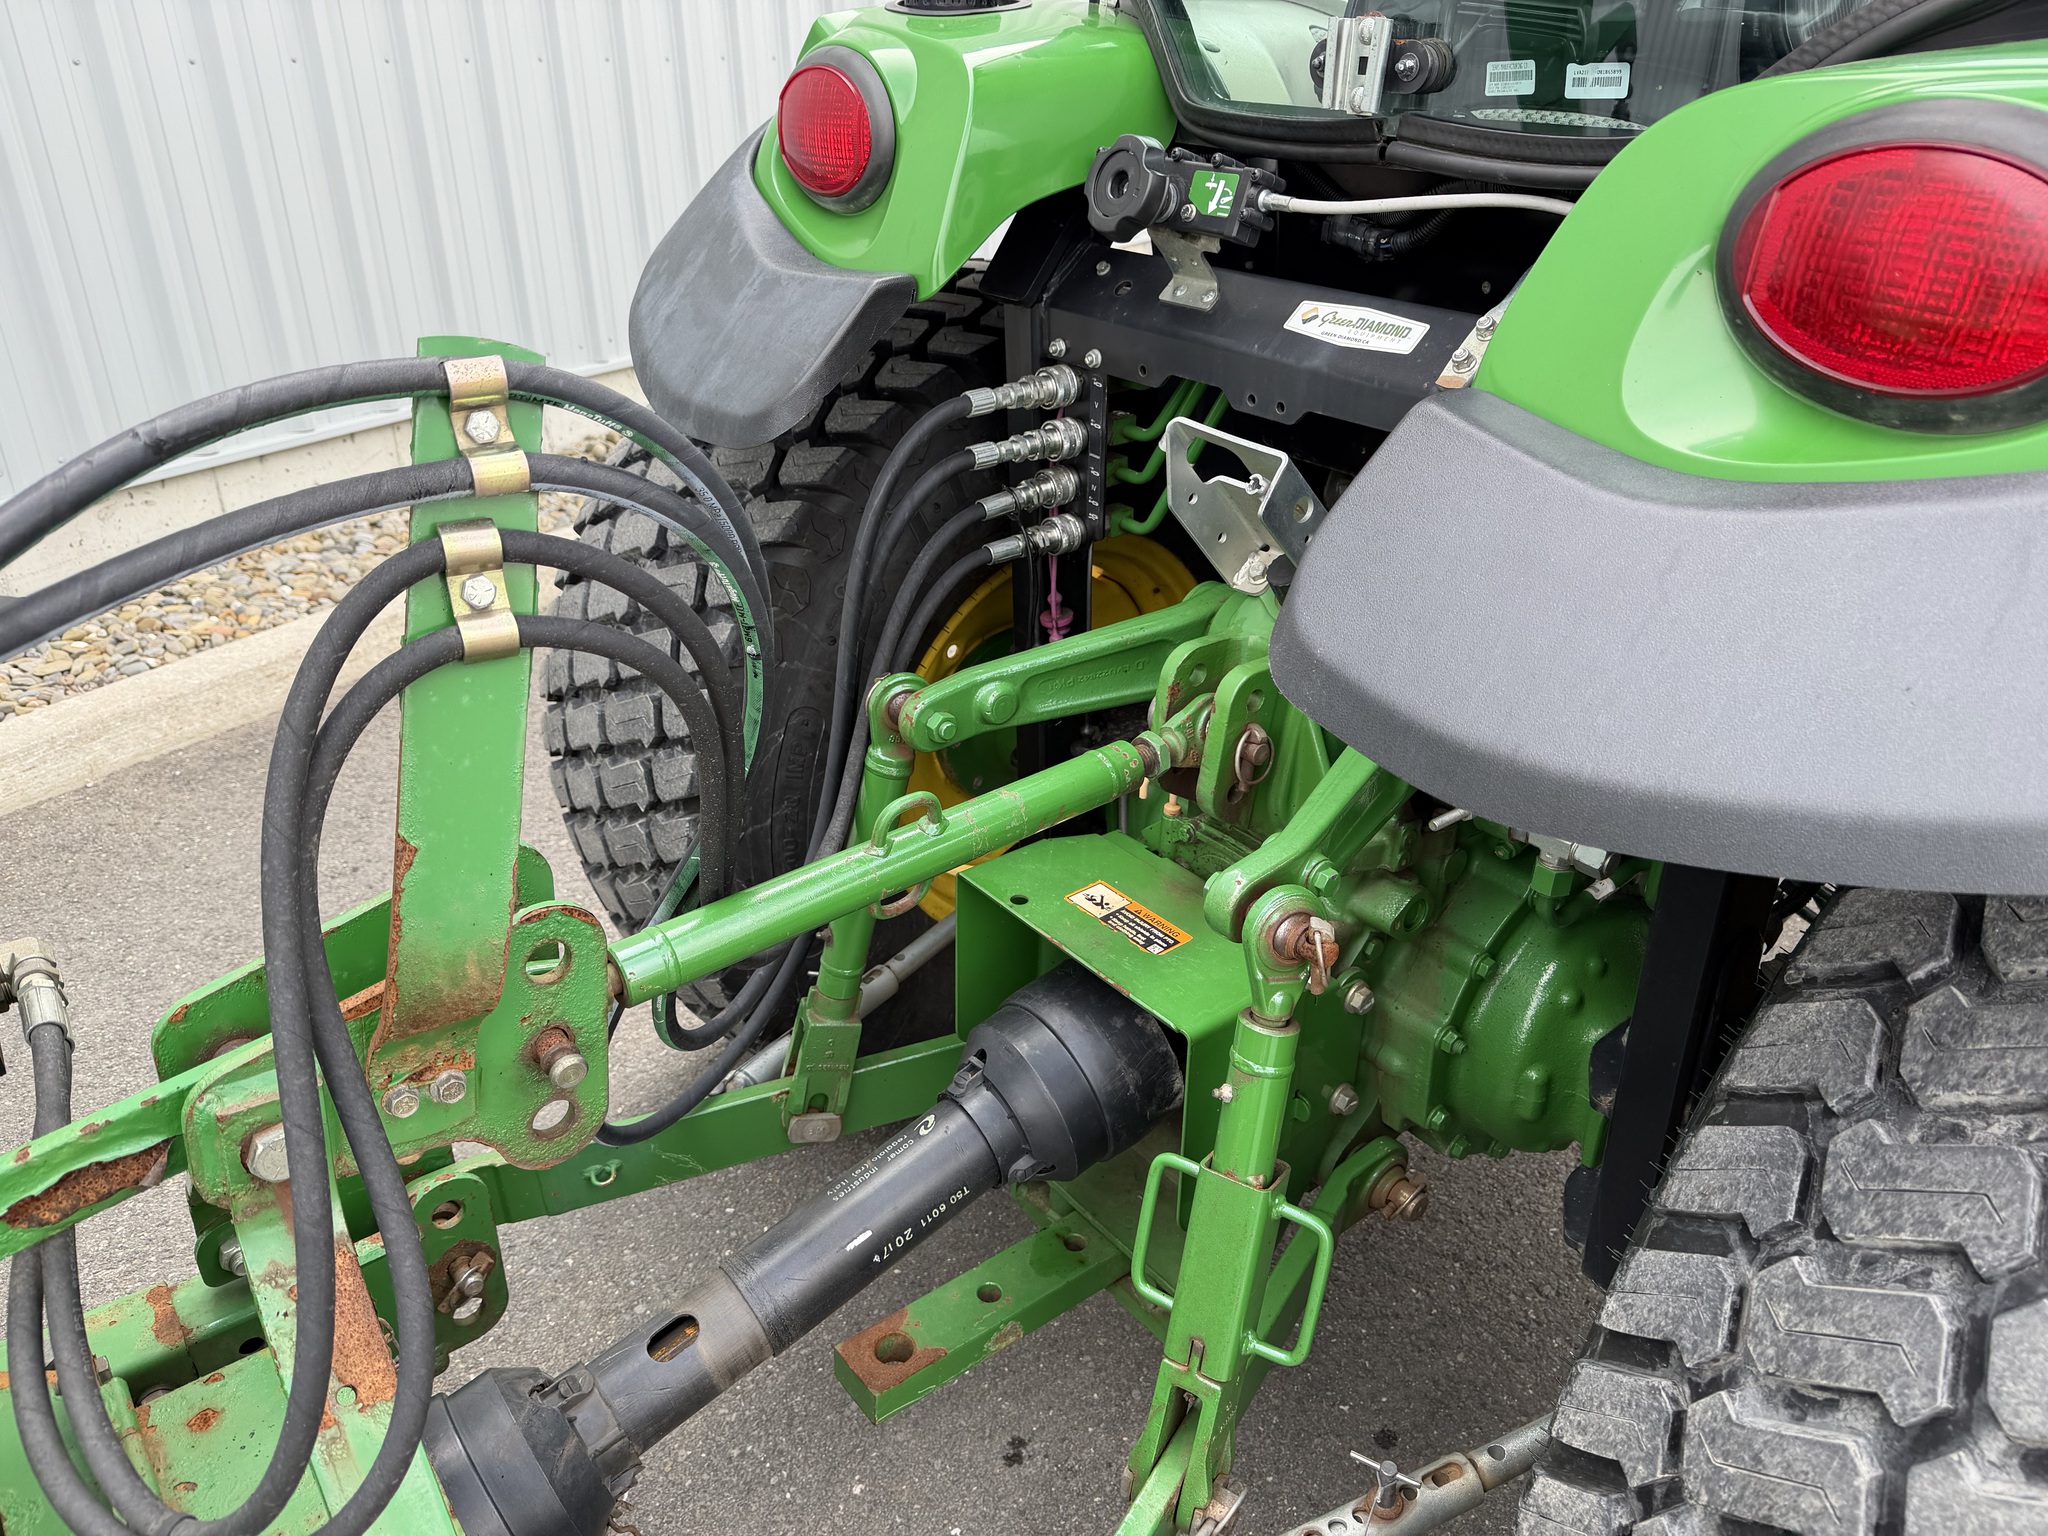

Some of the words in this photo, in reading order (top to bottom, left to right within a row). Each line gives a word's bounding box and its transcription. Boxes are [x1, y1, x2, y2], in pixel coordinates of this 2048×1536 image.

[1347, 330, 1401, 344] EQUIPMENT
[1120, 910, 1135, 919] AVOID
[1134, 918, 1151, 929] INJURY
[1150, 928, 1165, 938] FROM
[1141, 912, 1181, 938] WARNING
[887, 1139, 914, 1162] comer
[832, 1166, 878, 1201] industries
[950, 1186, 970, 1204] T50
[920, 1203, 946, 1227] 6011
